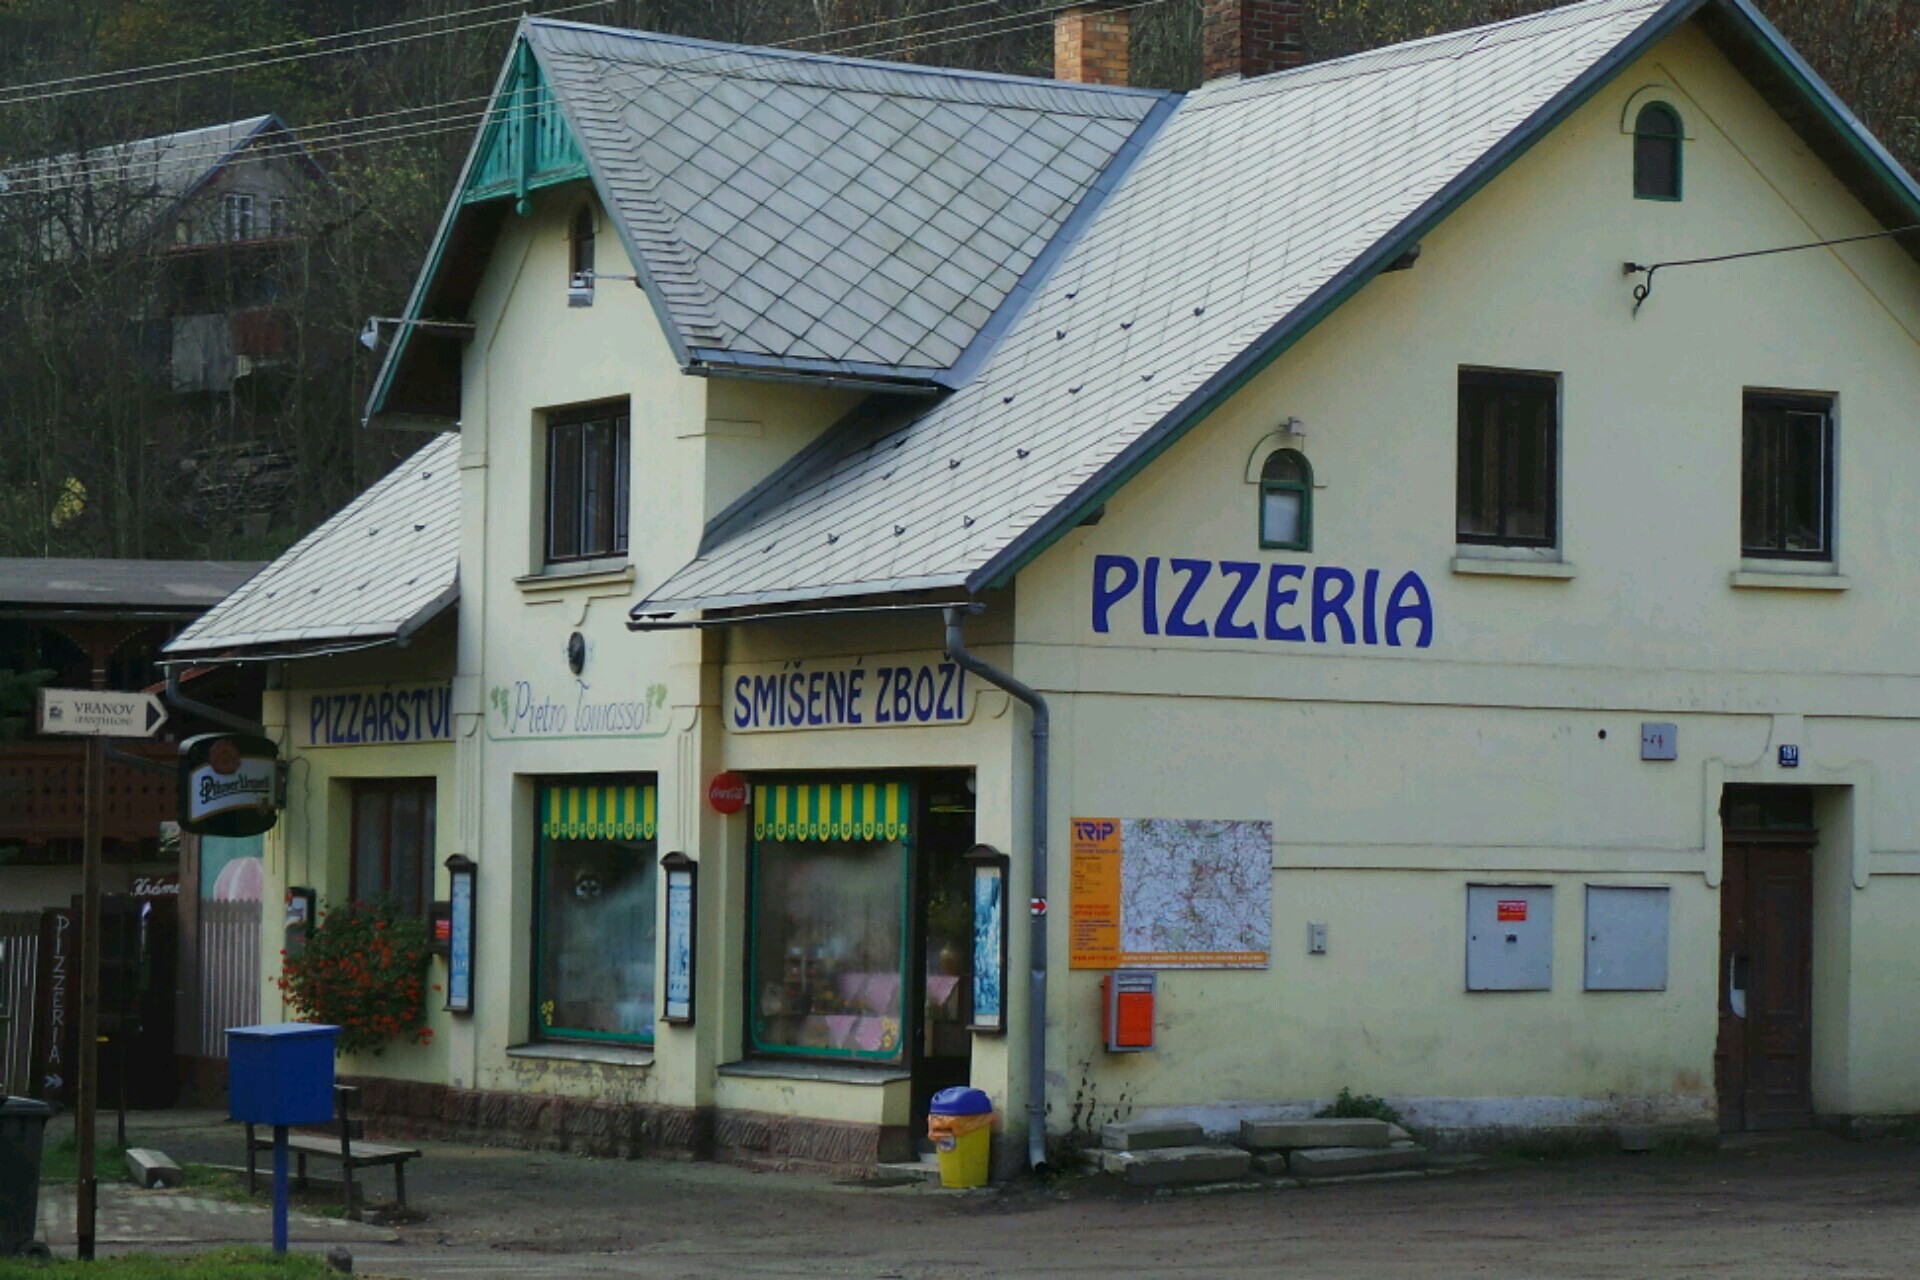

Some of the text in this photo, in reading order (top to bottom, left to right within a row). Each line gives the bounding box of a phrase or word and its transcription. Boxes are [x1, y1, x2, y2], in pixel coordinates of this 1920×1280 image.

[1092, 554, 1433, 648] PIZZERIA
[74, 702, 135, 716] VRANOV
[510, 680, 568, 734] Pietro
[734, 657, 866, 729] SMÍŠENÉ
[48, 913, 71, 1065] PIZZERIA
